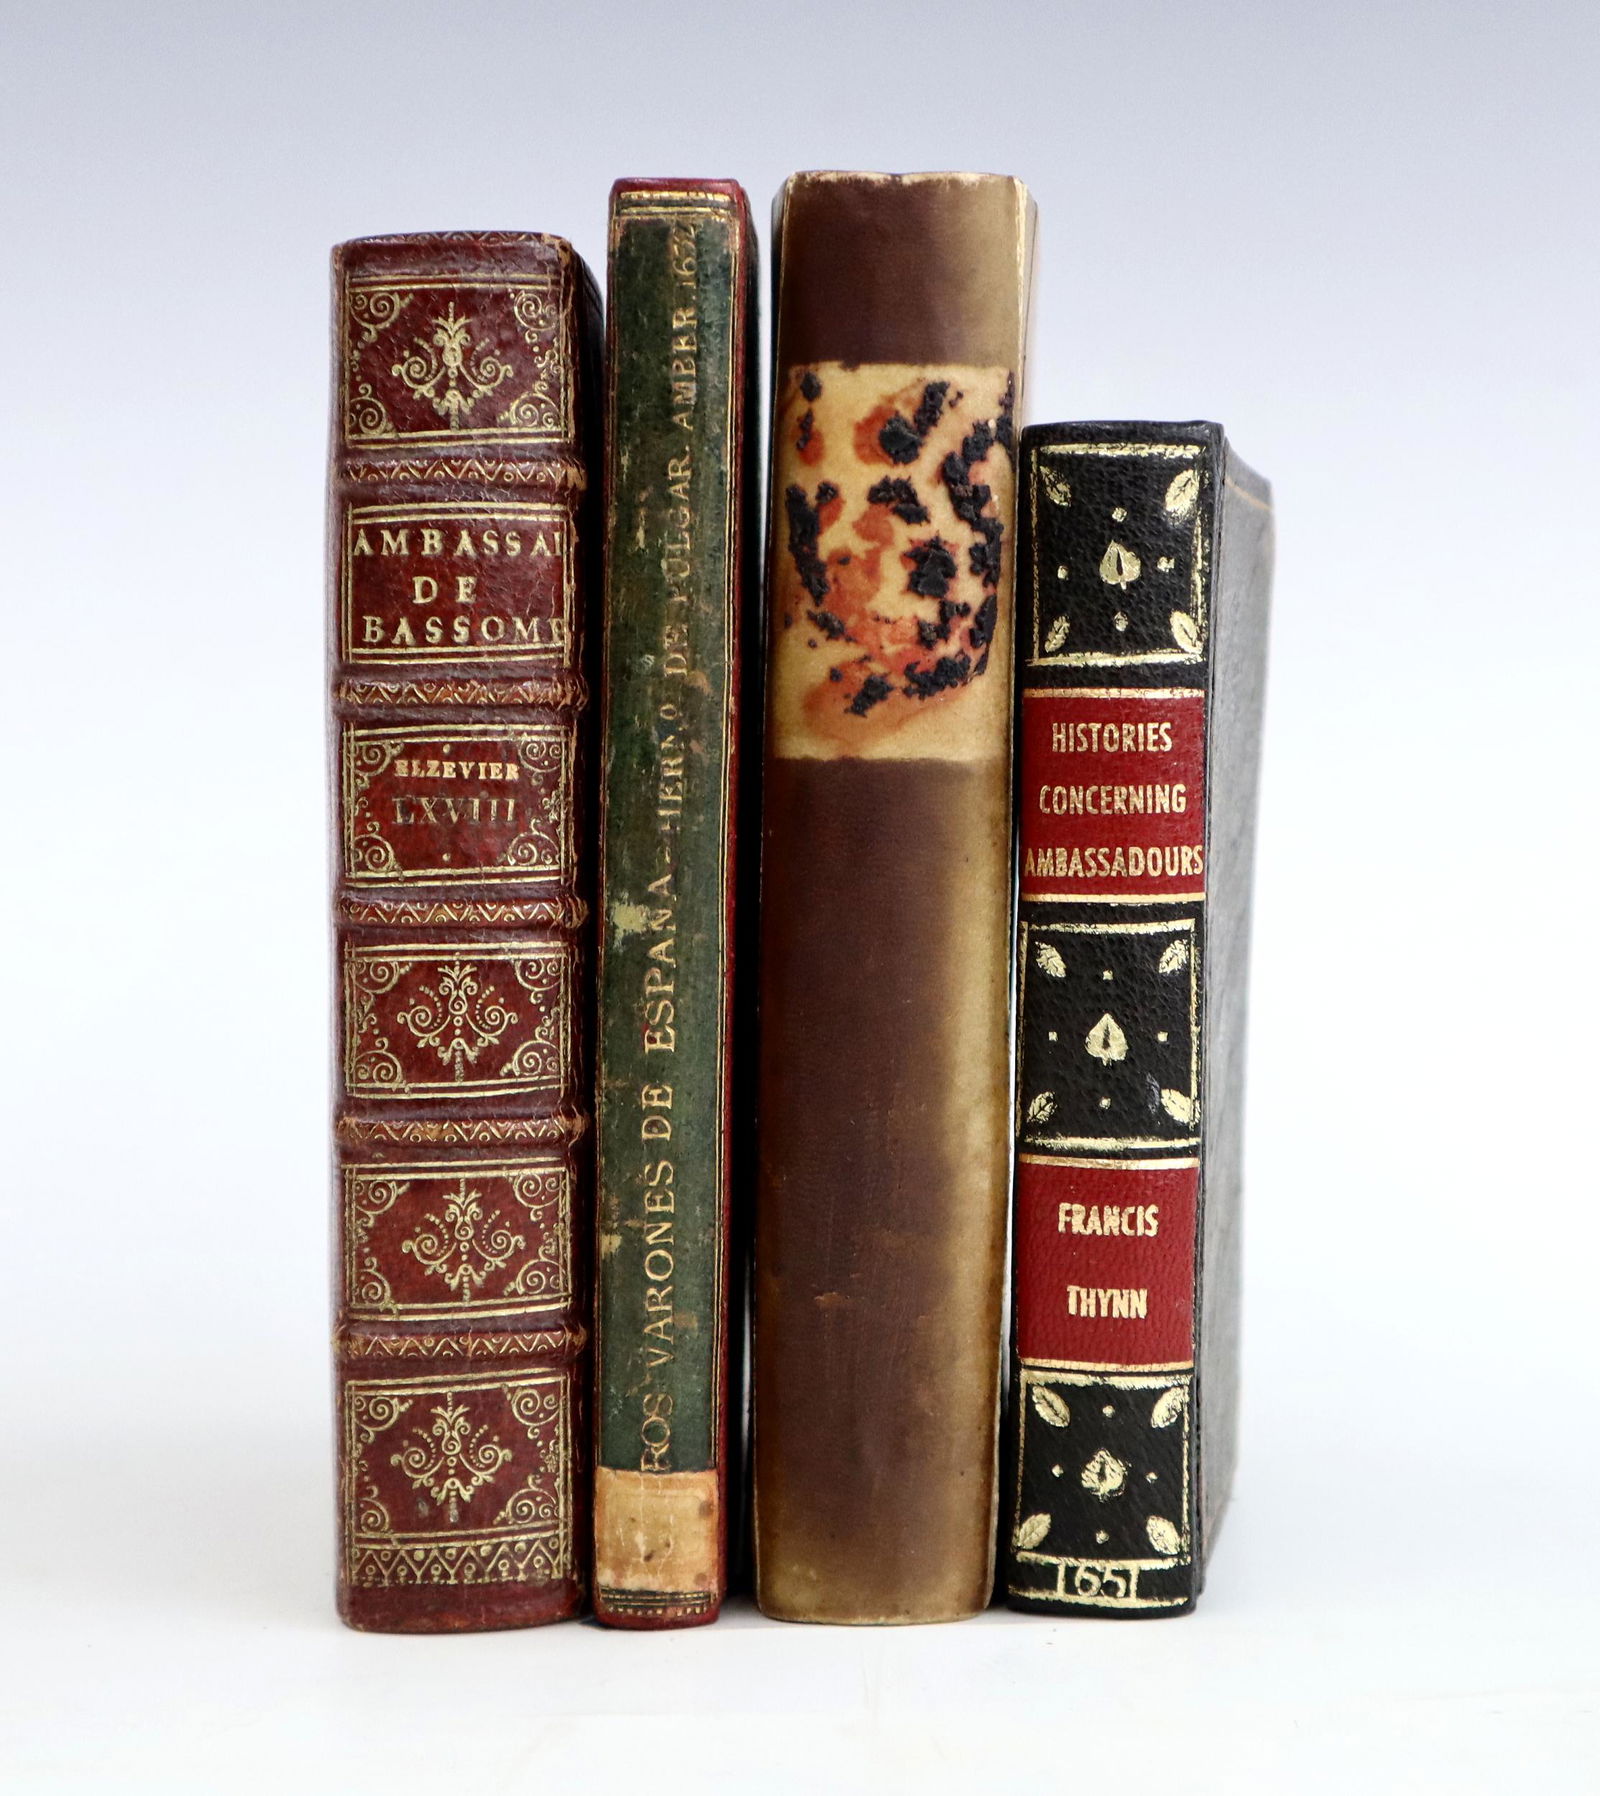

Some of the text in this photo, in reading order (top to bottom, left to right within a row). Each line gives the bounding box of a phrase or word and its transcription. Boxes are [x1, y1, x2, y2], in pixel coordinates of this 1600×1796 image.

[411, 575, 478, 605] DE
[662, 623, 689, 677] DE
[1051, 721, 1174, 754] HISTORIES
[394, 759, 520, 781] ELZEVIER
[391, 797, 516, 825] LXVIII
[1038, 783, 1188, 816] CONCERNING
[1023, 844, 1204, 878] AMBASSADOURS
[641, 1084, 674, 1142] DE
[1057, 1202, 1160, 1238] FRANCIS
[642, 1159, 676, 1369] VARONES
[1066, 1285, 1149, 1320] THYNN
[1056, 1562, 1140, 1600] 1651
